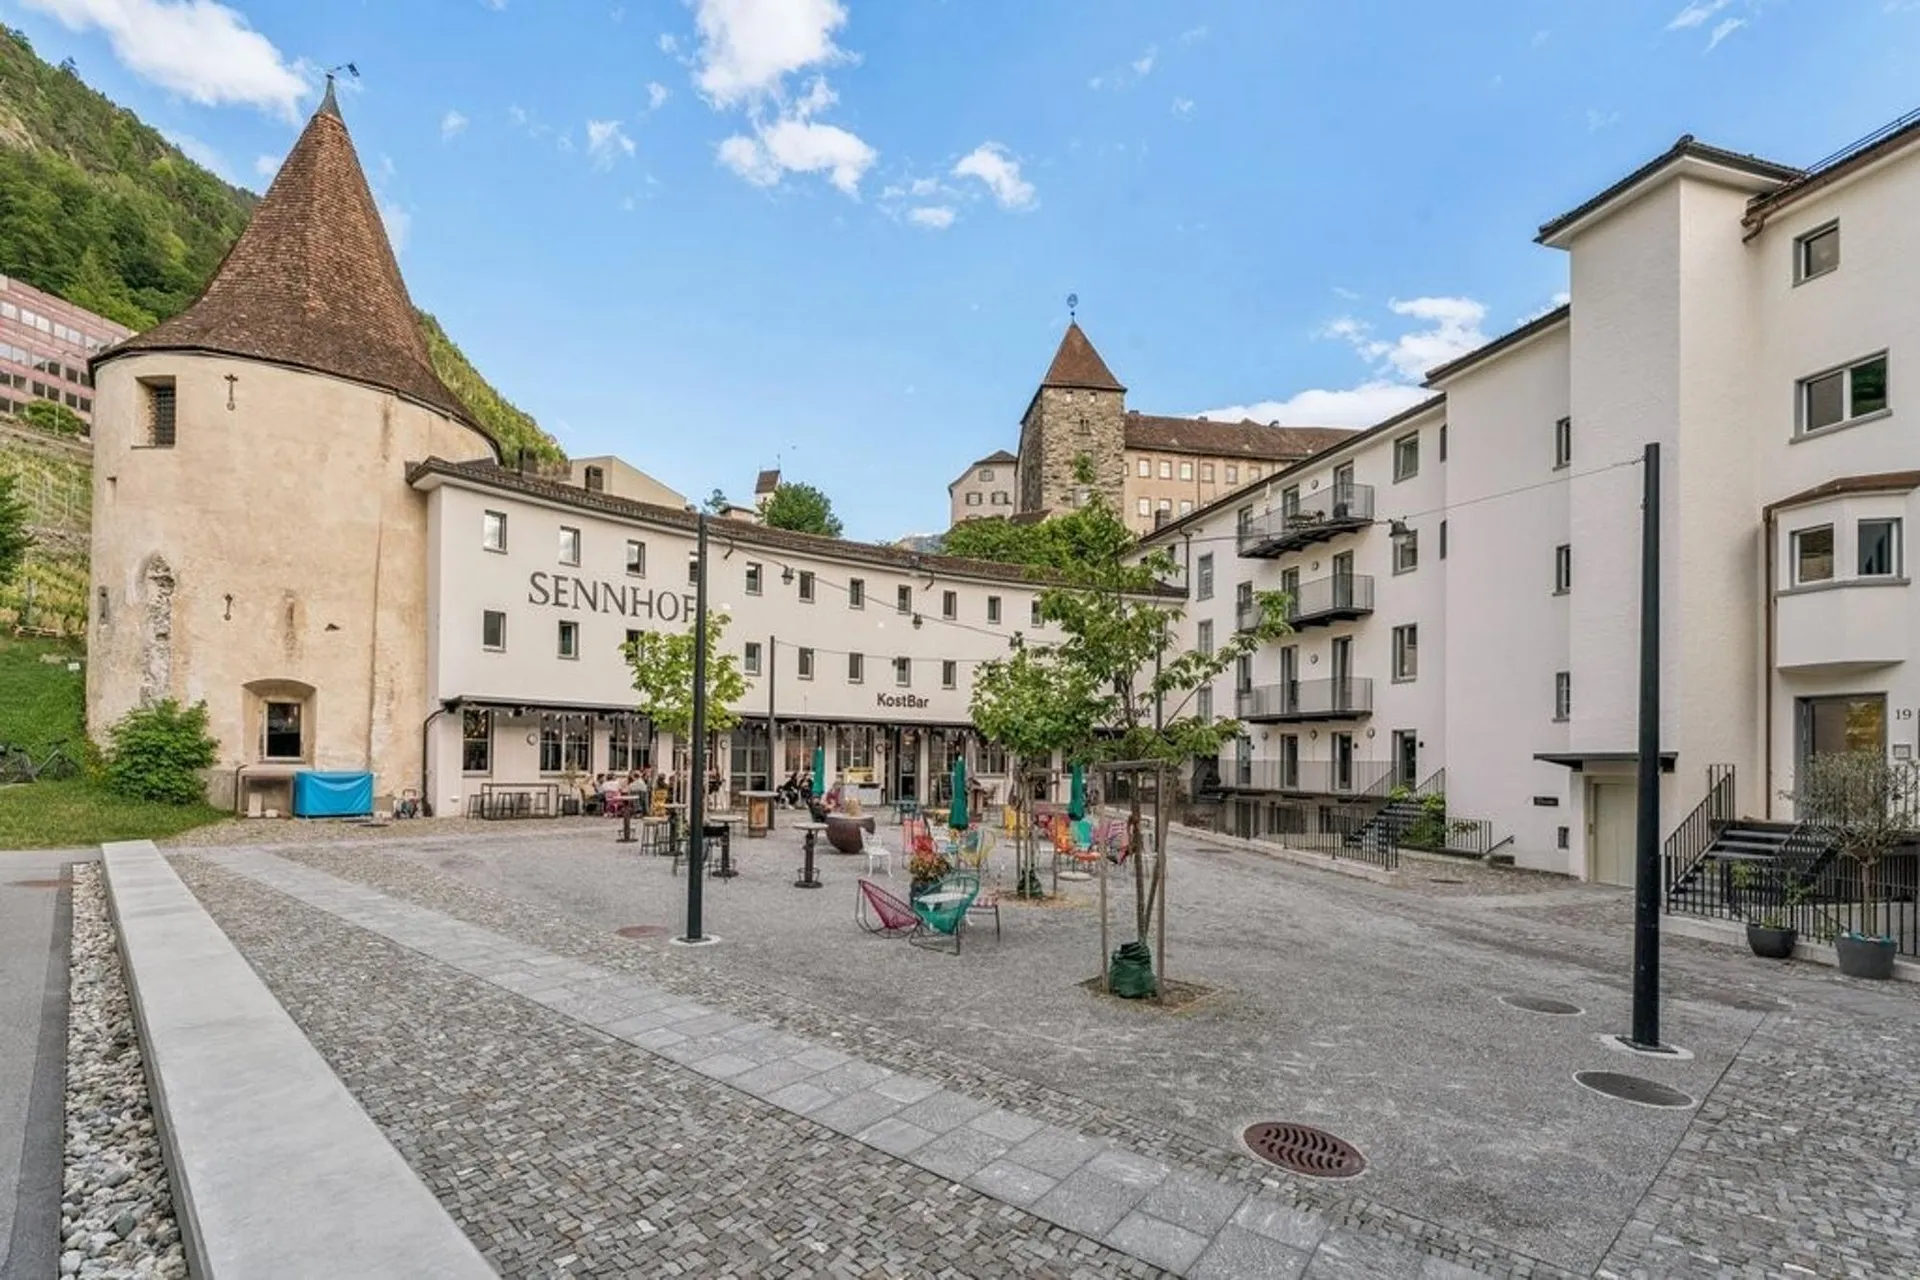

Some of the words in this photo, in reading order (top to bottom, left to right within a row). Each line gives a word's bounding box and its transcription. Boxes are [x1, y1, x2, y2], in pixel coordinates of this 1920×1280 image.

[528, 571, 697, 624] SENNHOF
[877, 692, 929, 708] KostBar
[1896, 708, 1912, 720] 19
